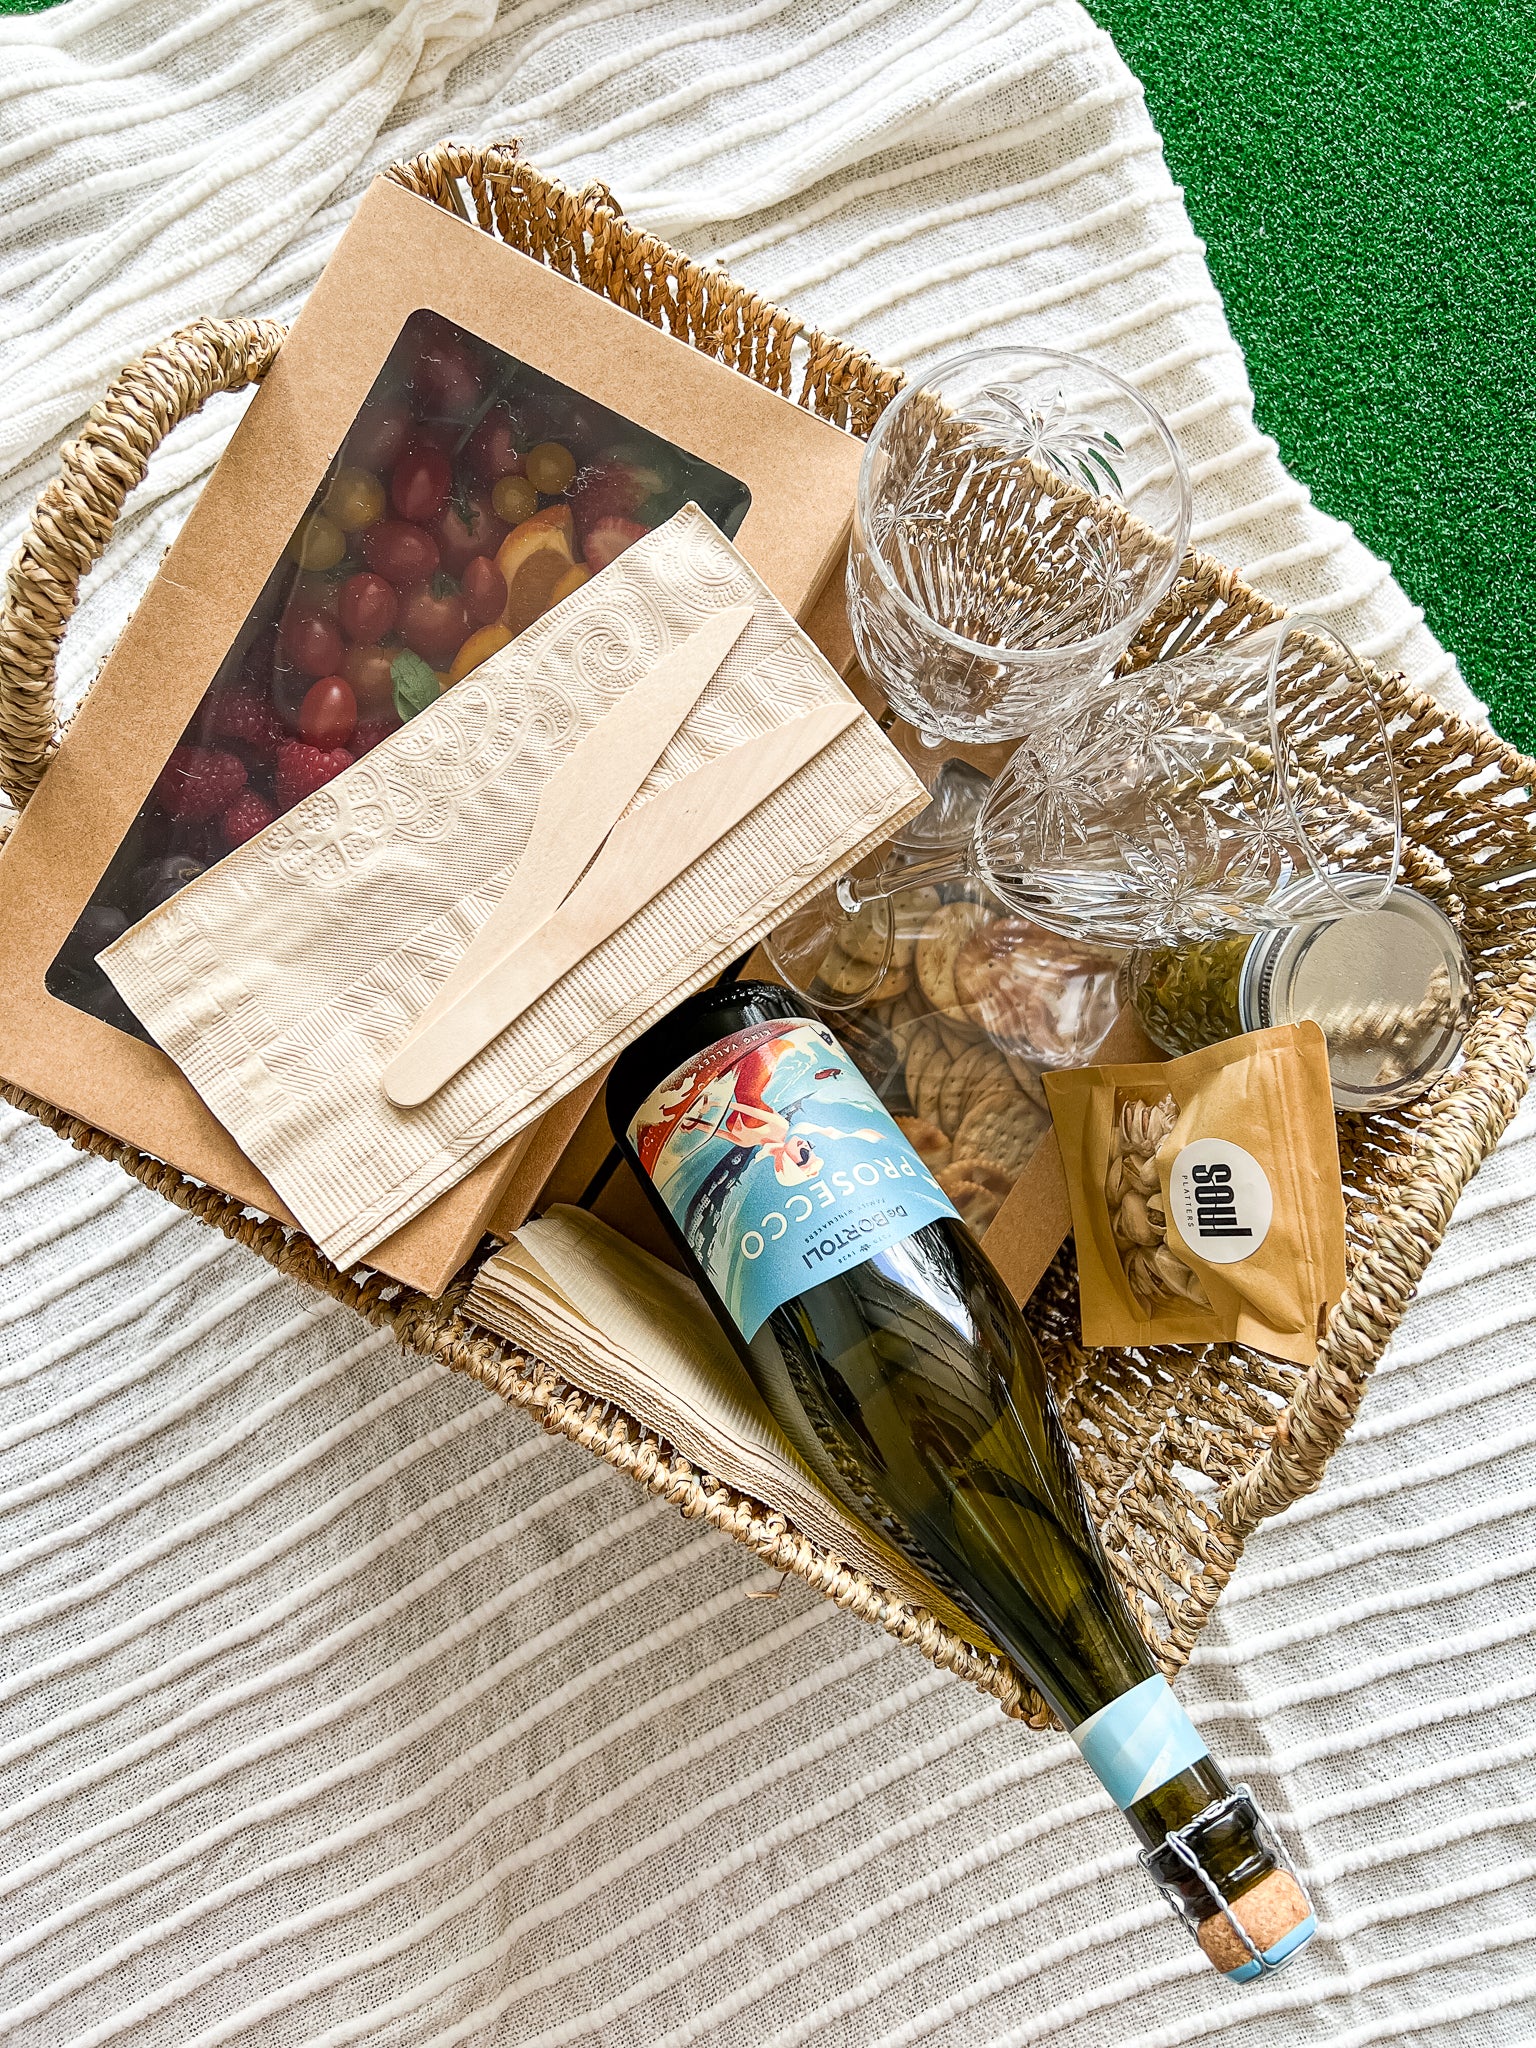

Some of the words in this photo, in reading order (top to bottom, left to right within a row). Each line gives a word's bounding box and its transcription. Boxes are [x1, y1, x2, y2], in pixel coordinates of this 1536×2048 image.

[743, 1029, 772, 1045] KING
[697, 1043, 739, 1071] VALLEY
[740, 1155, 917, 1260] PROSECCO
[1181, 1174, 1195, 1228] PLATTERS
[804, 1208, 855, 1244] WINEMAKERS
